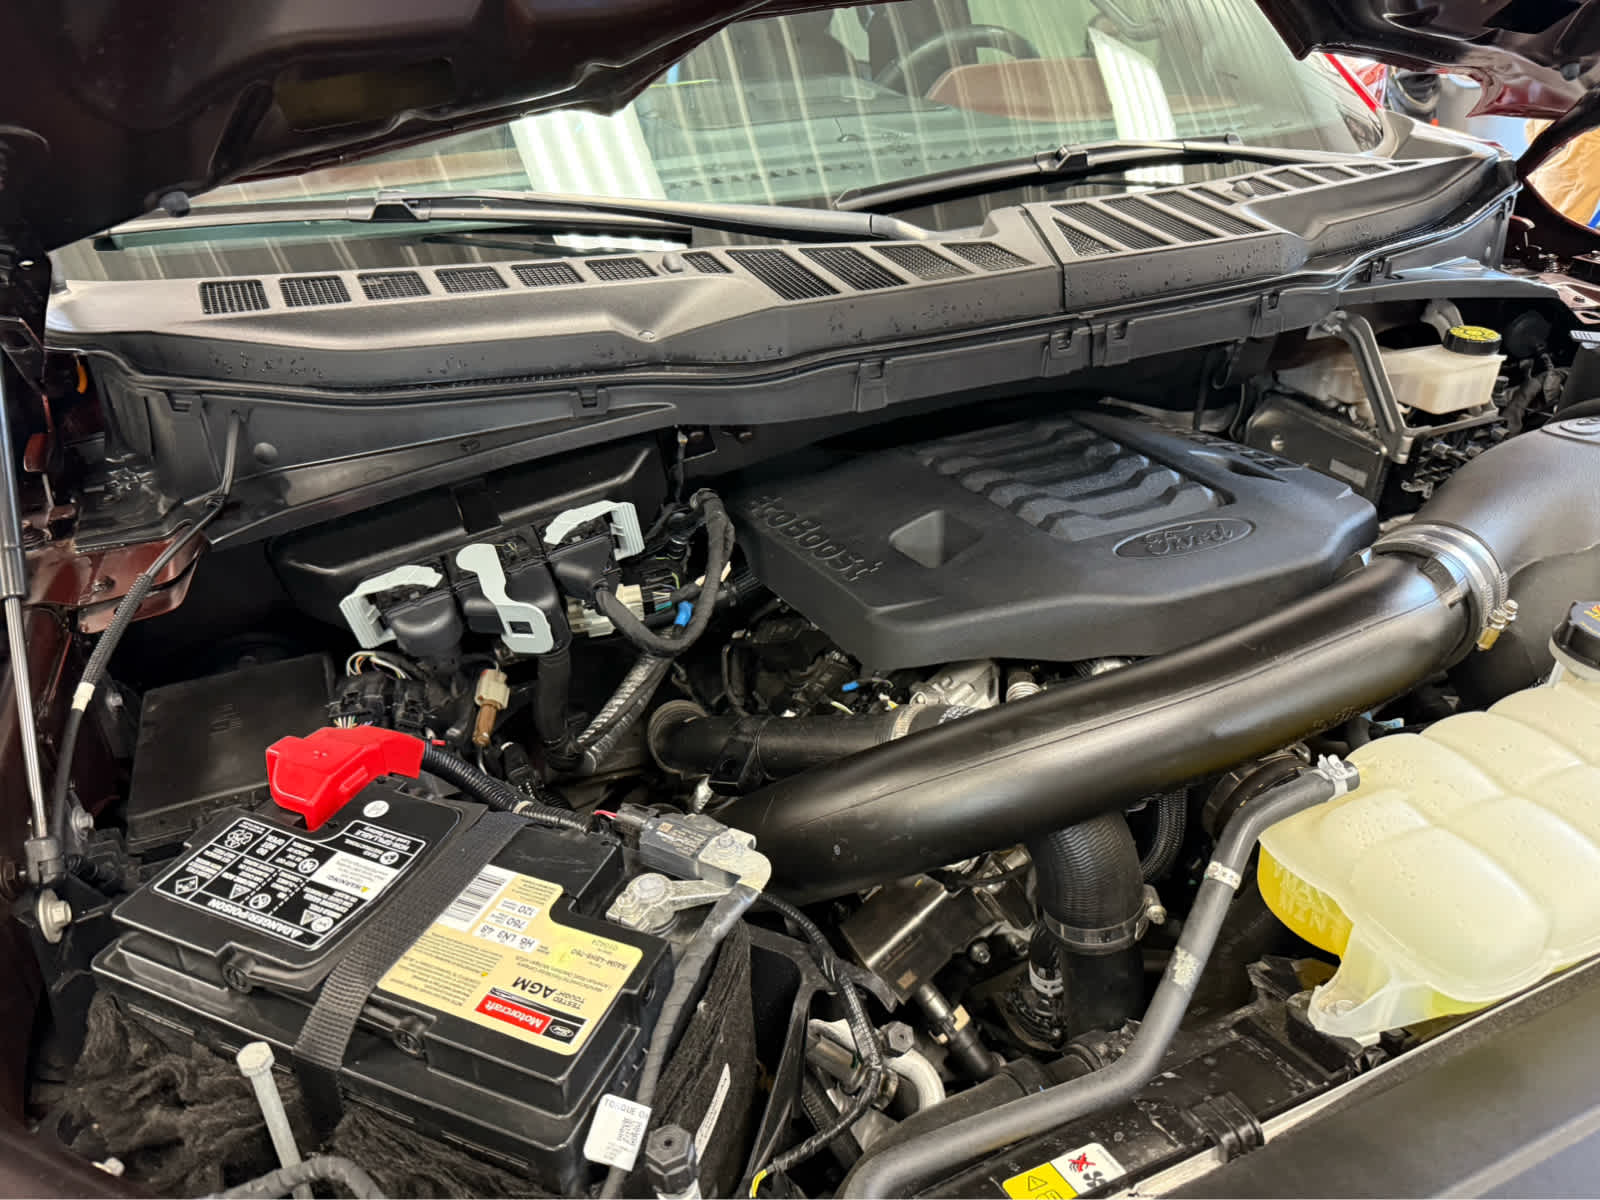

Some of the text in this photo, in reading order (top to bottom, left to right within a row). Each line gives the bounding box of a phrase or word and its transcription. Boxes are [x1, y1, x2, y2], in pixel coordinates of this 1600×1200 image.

[1144, 521, 1234, 556] Ford
[518, 905, 535, 916] 120
[480, 924, 535, 947] H6 LN3 48
[512, 976, 557, 999] AGM
[484, 1000, 544, 1028] Motorcraft
